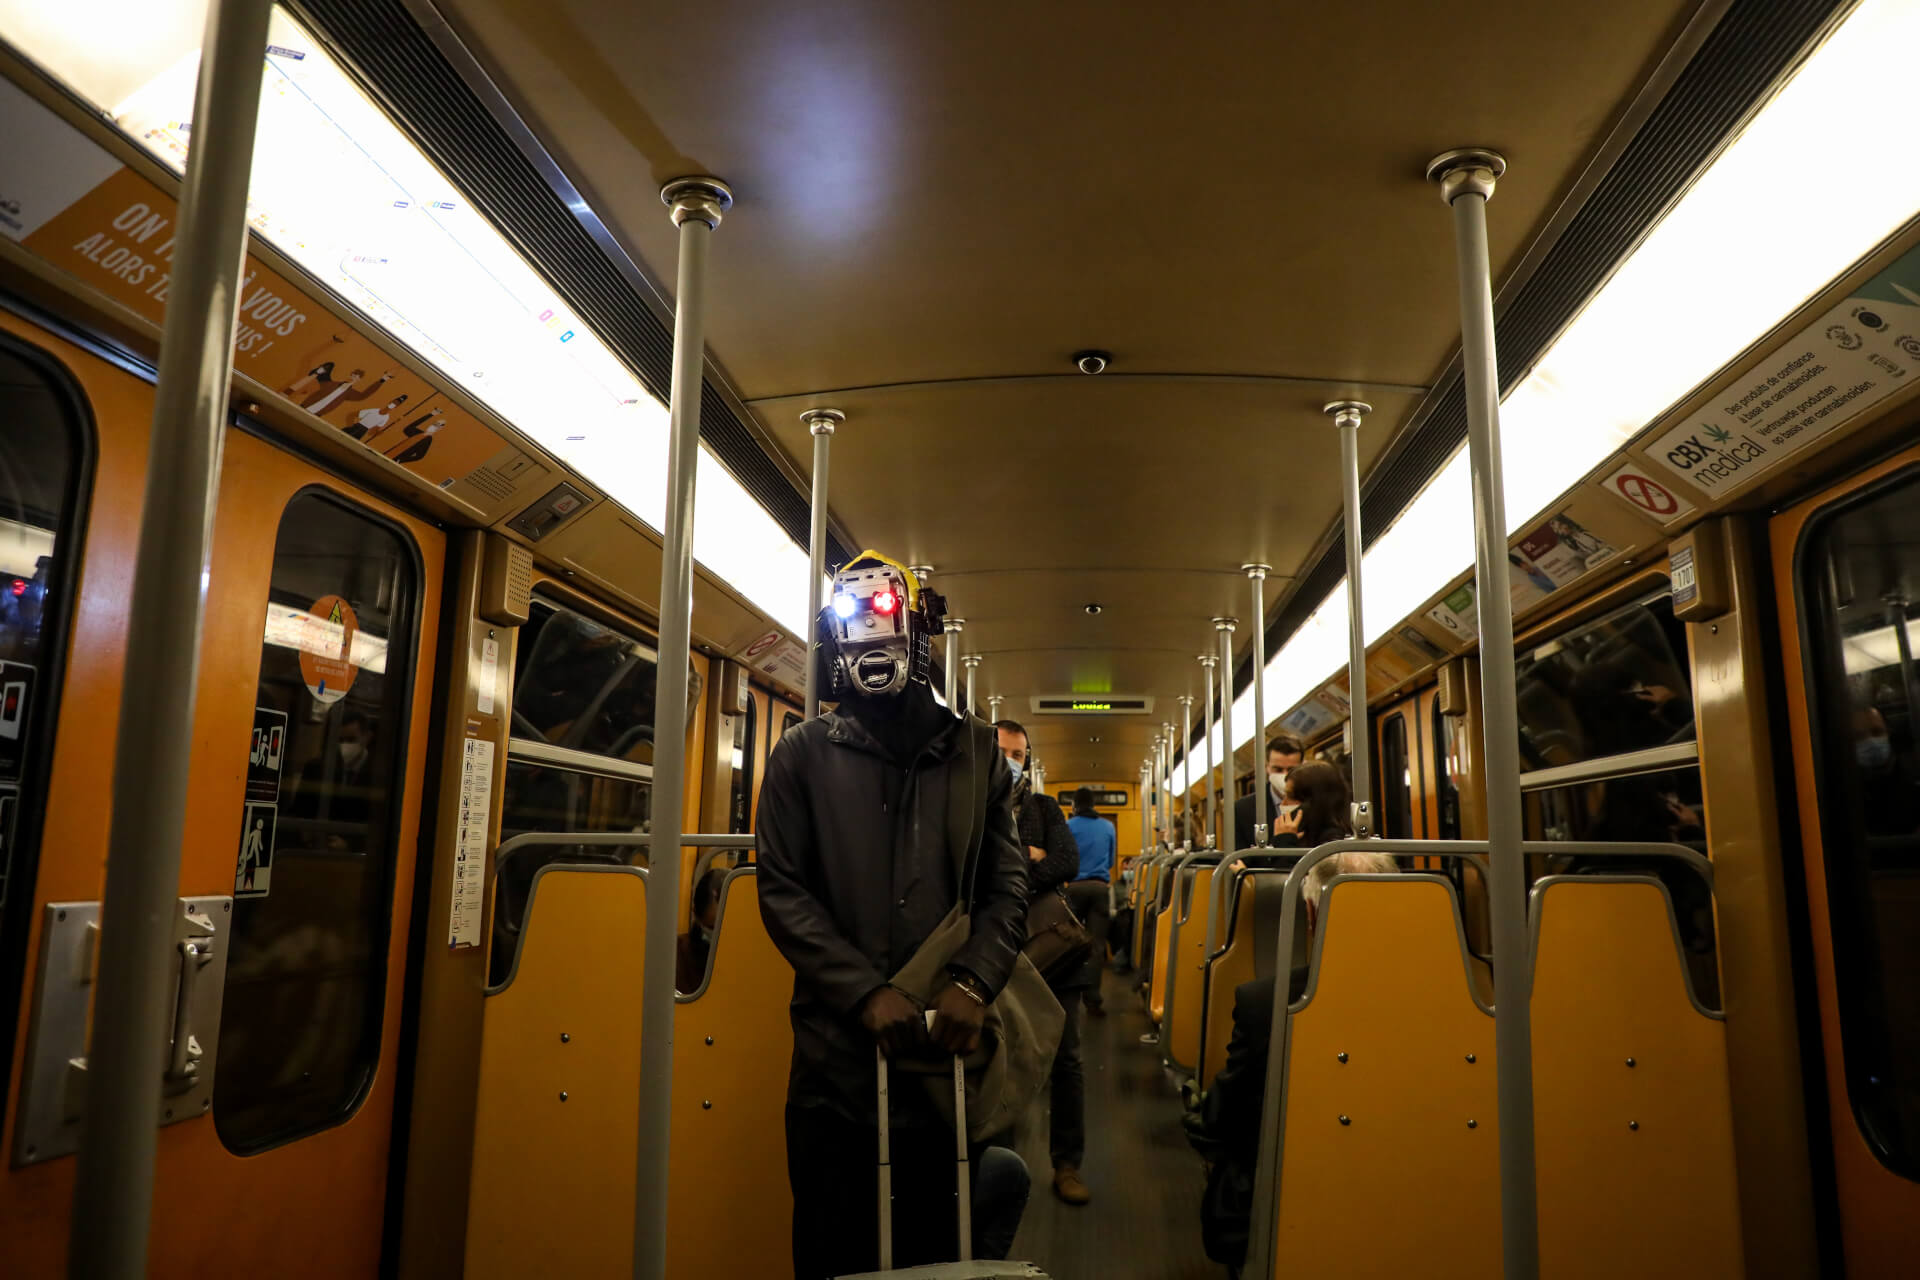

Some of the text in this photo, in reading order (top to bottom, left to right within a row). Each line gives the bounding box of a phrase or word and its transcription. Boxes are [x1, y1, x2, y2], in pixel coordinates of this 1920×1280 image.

[73, 232, 155, 286] ALORS
[112, 203, 306, 336] ON VOUS
[1724, 351, 1816, 416] Des produits de confiance
[1747, 406, 1763, 421] base
[1761, 399, 1774, 410] de
[1756, 384, 1838, 437] Vertrouwde producten
[1772, 436, 1785, 446] op
[1783, 425, 1802, 441] basis
[1801, 416, 1817, 429] van
[1666, 435, 1716, 470] CBX
[1694, 434, 1768, 487] medical
